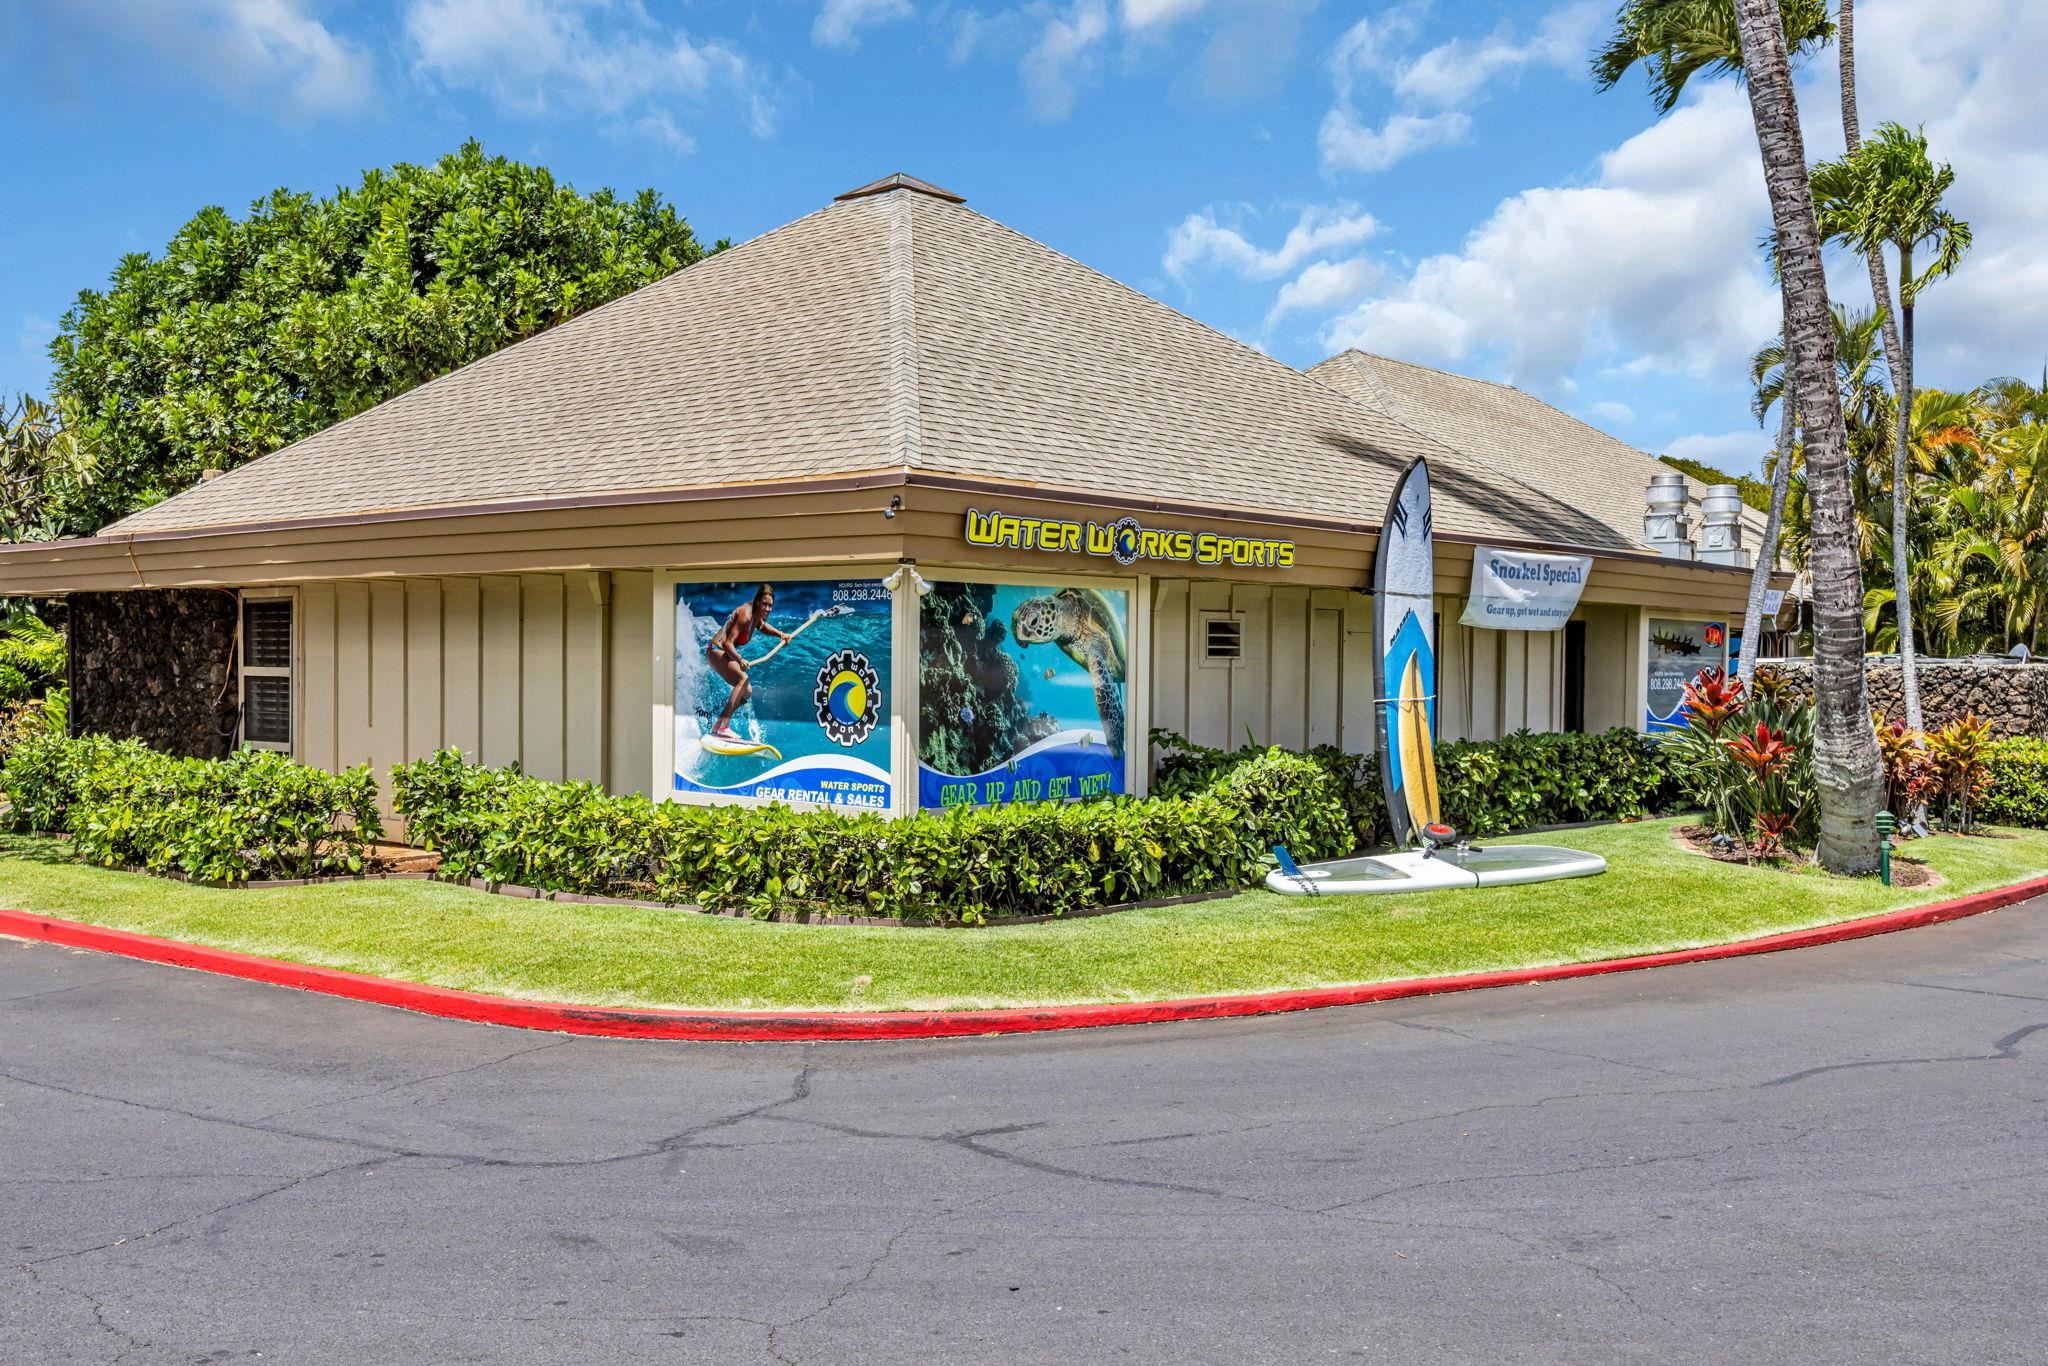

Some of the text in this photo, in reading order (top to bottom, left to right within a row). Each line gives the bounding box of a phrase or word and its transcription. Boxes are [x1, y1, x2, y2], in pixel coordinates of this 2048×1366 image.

[1490, 559, 1582, 585] Snorkel Special
[832, 589, 893, 601] 808.298.2446
[1486, 603, 1504, 615] Gear
[1505, 607, 1516, 617] up,
[1516, 607, 1528, 617] get
[1528, 607, 1540, 616] wet
[1540, 607, 1551, 617] and
[1551, 608, 1563, 619] stay
[822, 663, 873, 708] WATER WORKS
[826, 713, 869, 734] SPORTS
[755, 786, 885, 807] GEAR RENTAL & SALES
[820, 780, 885, 793] WATER SPORTS
[940, 771, 1112, 807] GEAR UP AND GET WET!
